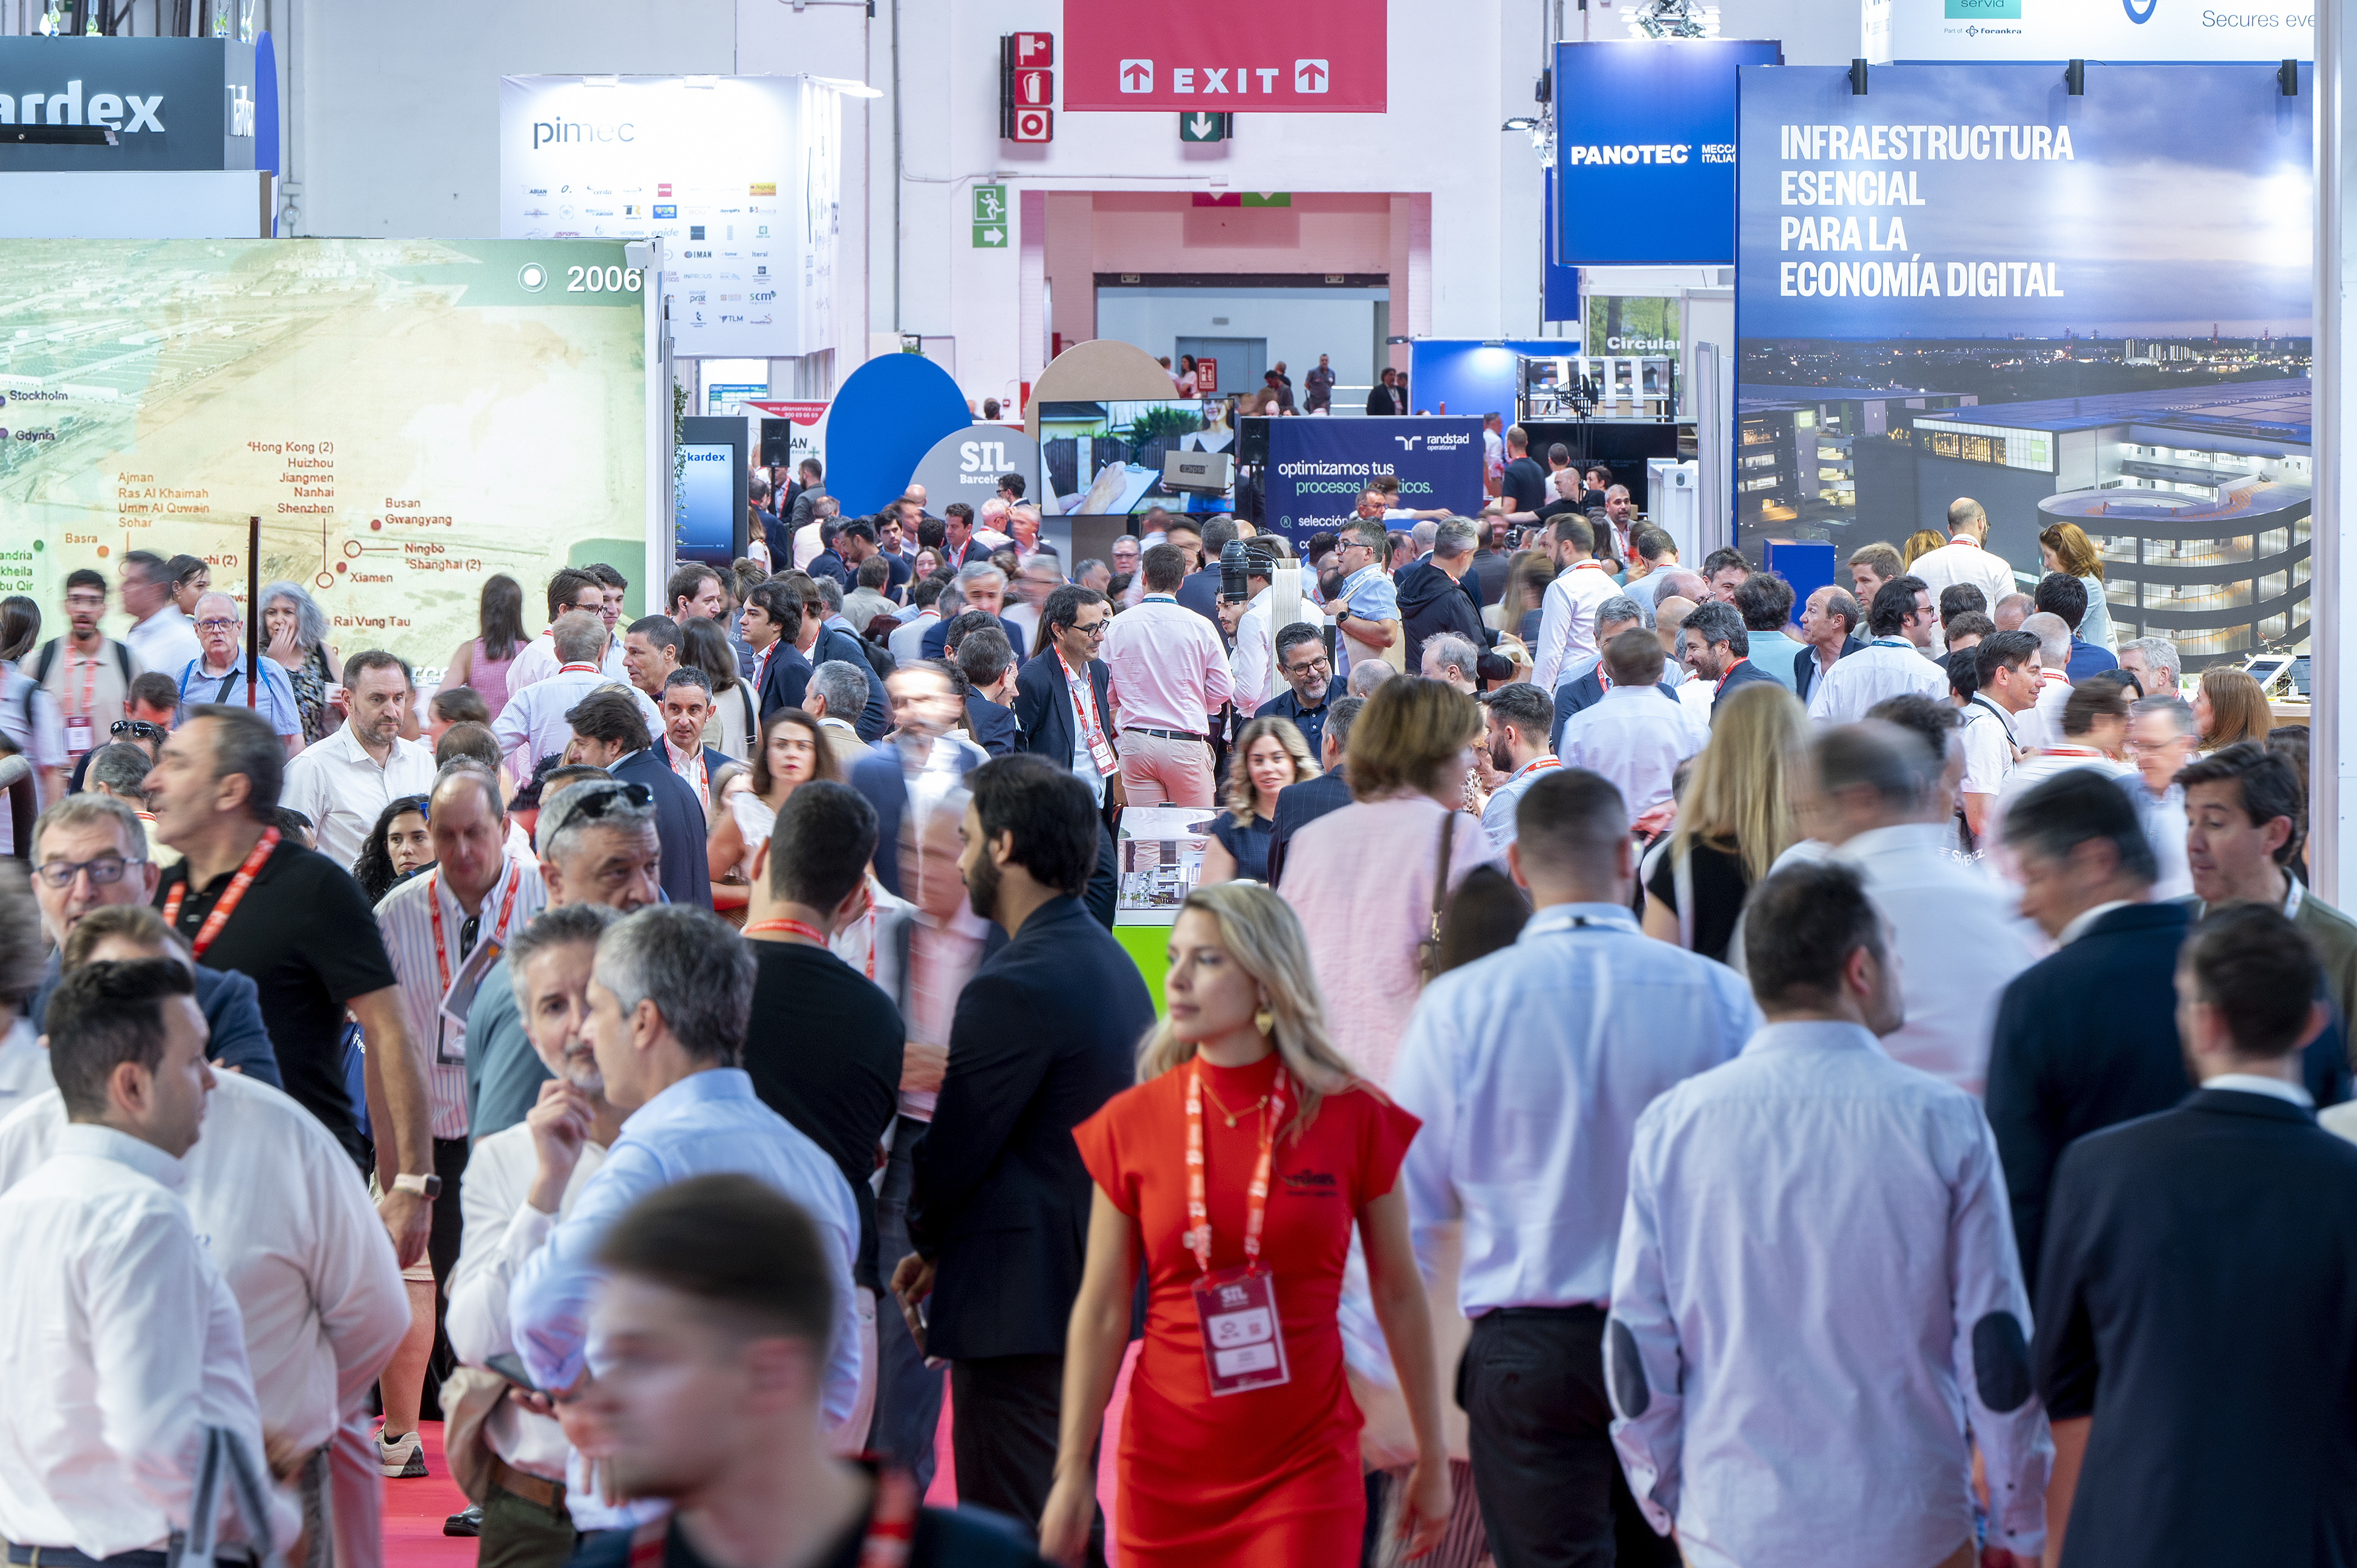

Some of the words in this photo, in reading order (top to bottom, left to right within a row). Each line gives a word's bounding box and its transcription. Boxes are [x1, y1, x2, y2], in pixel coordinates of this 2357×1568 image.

[2202, 10, 2279, 27] Secures
[1174, 68, 1279, 93] EXIT
[533, 116, 635, 149] pimec
[1781, 125, 2075, 160] INFRAESTRUCTURA
[1571, 145, 1689, 164] PANOTEC
[1781, 171, 1925, 206] ESENCIAL
[1781, 216, 1862, 252] PARA
[1868, 216, 1908, 252] LA
[567, 265, 642, 293] 2006
[1780, 253, 1941, 297] ECONOMÍA
[1947, 262, 2064, 297] DIGITAL
[10, 391, 68, 401] Stockholm
[16, 431, 55, 441] Gdynia
[1427, 433, 1469, 444] randstad
[285, 441, 315, 454] Kong
[318, 441, 334, 454] (2)
[687, 452, 726, 461] kardex
[960, 441, 1015, 472] SIL
[287, 458, 334, 468] Huizhou
[1278, 460, 1370, 478] optimizamos
[1372, 461, 1394, 475] tus
[118, 473, 154, 484] Ajman
[279, 473, 334, 483] Jiangmen
[119, 489, 141, 498] Ras
[144, 488, 156, 498] Al
[159, 488, 209, 498] Khaimah
[294, 487, 334, 498] Nanhai
[1296, 481, 1361, 496] procesos
[119, 503, 148, 513] Umm
[152, 503, 163, 513] Al
[166, 503, 210, 514] Quwain
[278, 503, 334, 513] Shenzhen
[385, 498, 420, 509] Busan
[119, 517, 152, 527] Sohar
[385, 514, 452, 526] Gwangyang
[1298, 515, 1348, 527] selección
[65, 533, 98, 544] Basra
[405, 543, 445, 555] Ningbo
[222, 555, 238, 567] (2)
[466, 558, 481, 571] (2)
[349, 573, 393, 583] Xiamen
[16, 581, 34, 591] Qir
[334, 616, 353, 626] Rai
[355, 616, 386, 629] Vung
[389, 616, 411, 626] Tau
